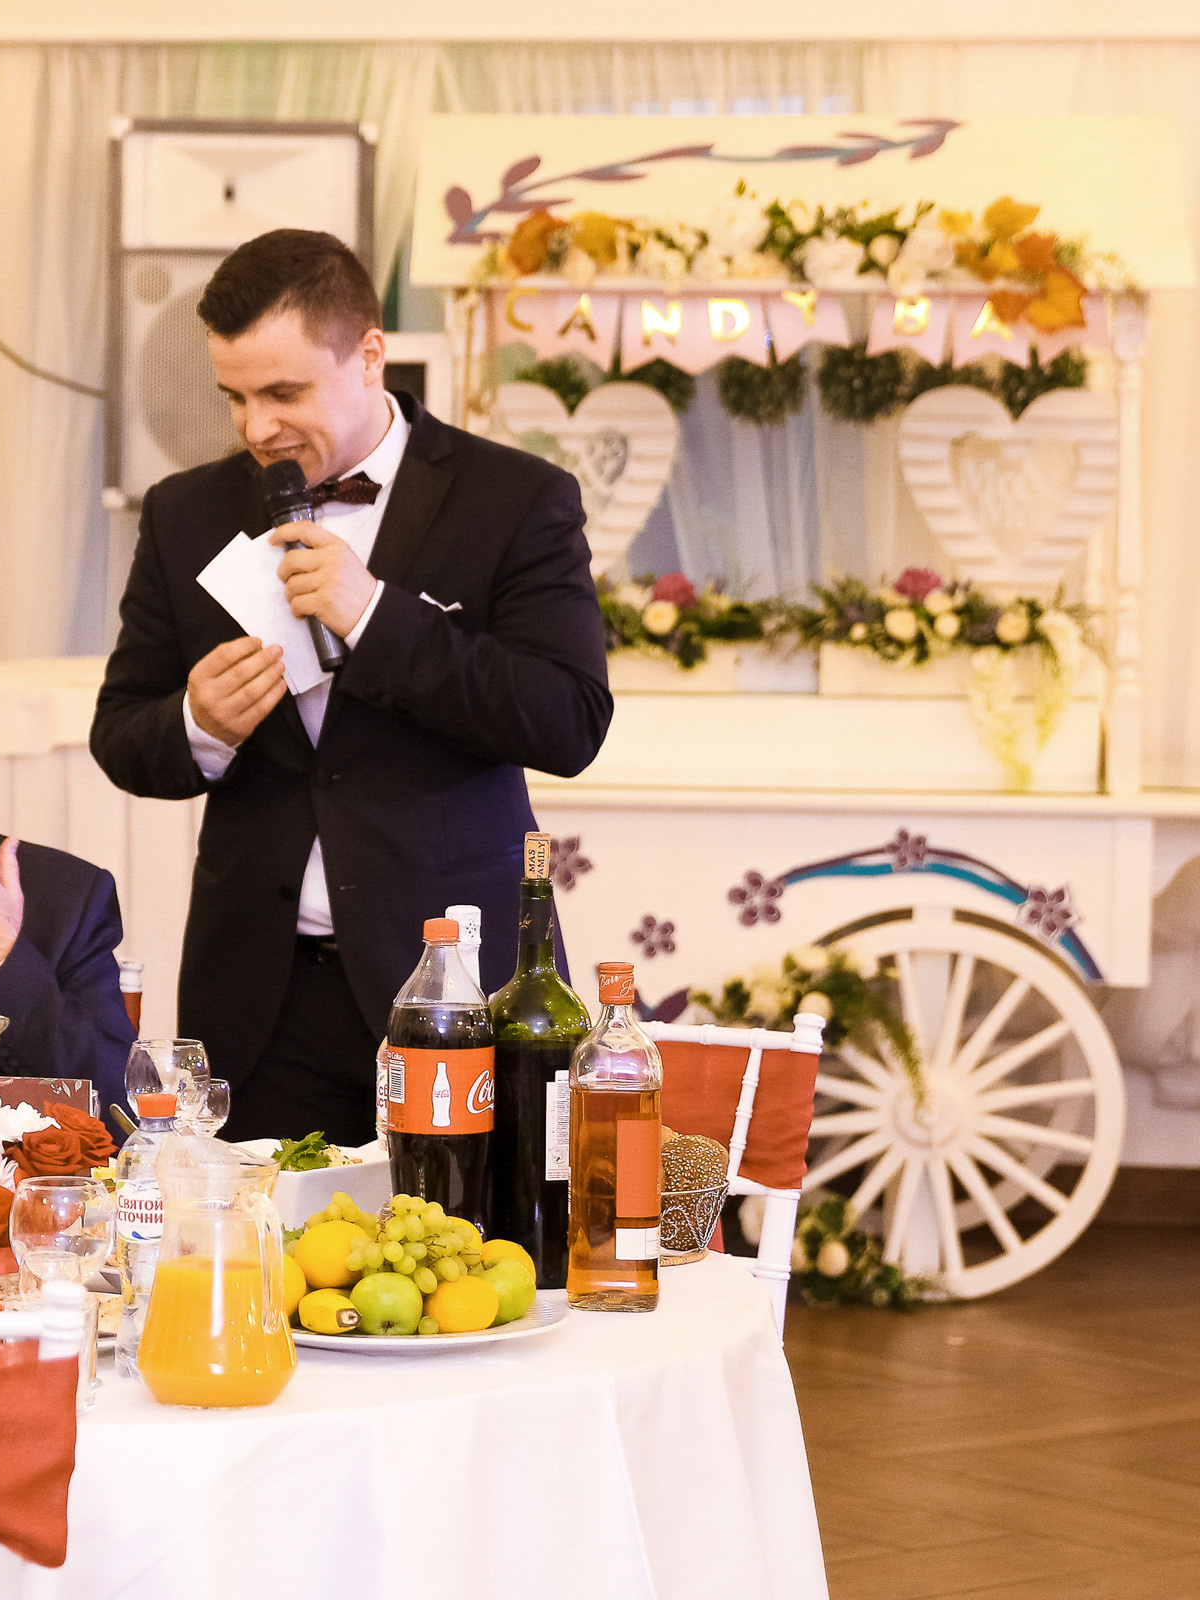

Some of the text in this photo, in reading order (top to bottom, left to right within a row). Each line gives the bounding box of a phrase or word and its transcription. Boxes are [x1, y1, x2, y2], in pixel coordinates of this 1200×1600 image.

[504, 287, 1013, 347] CANDY BA
[528, 849, 536, 874] MAS
